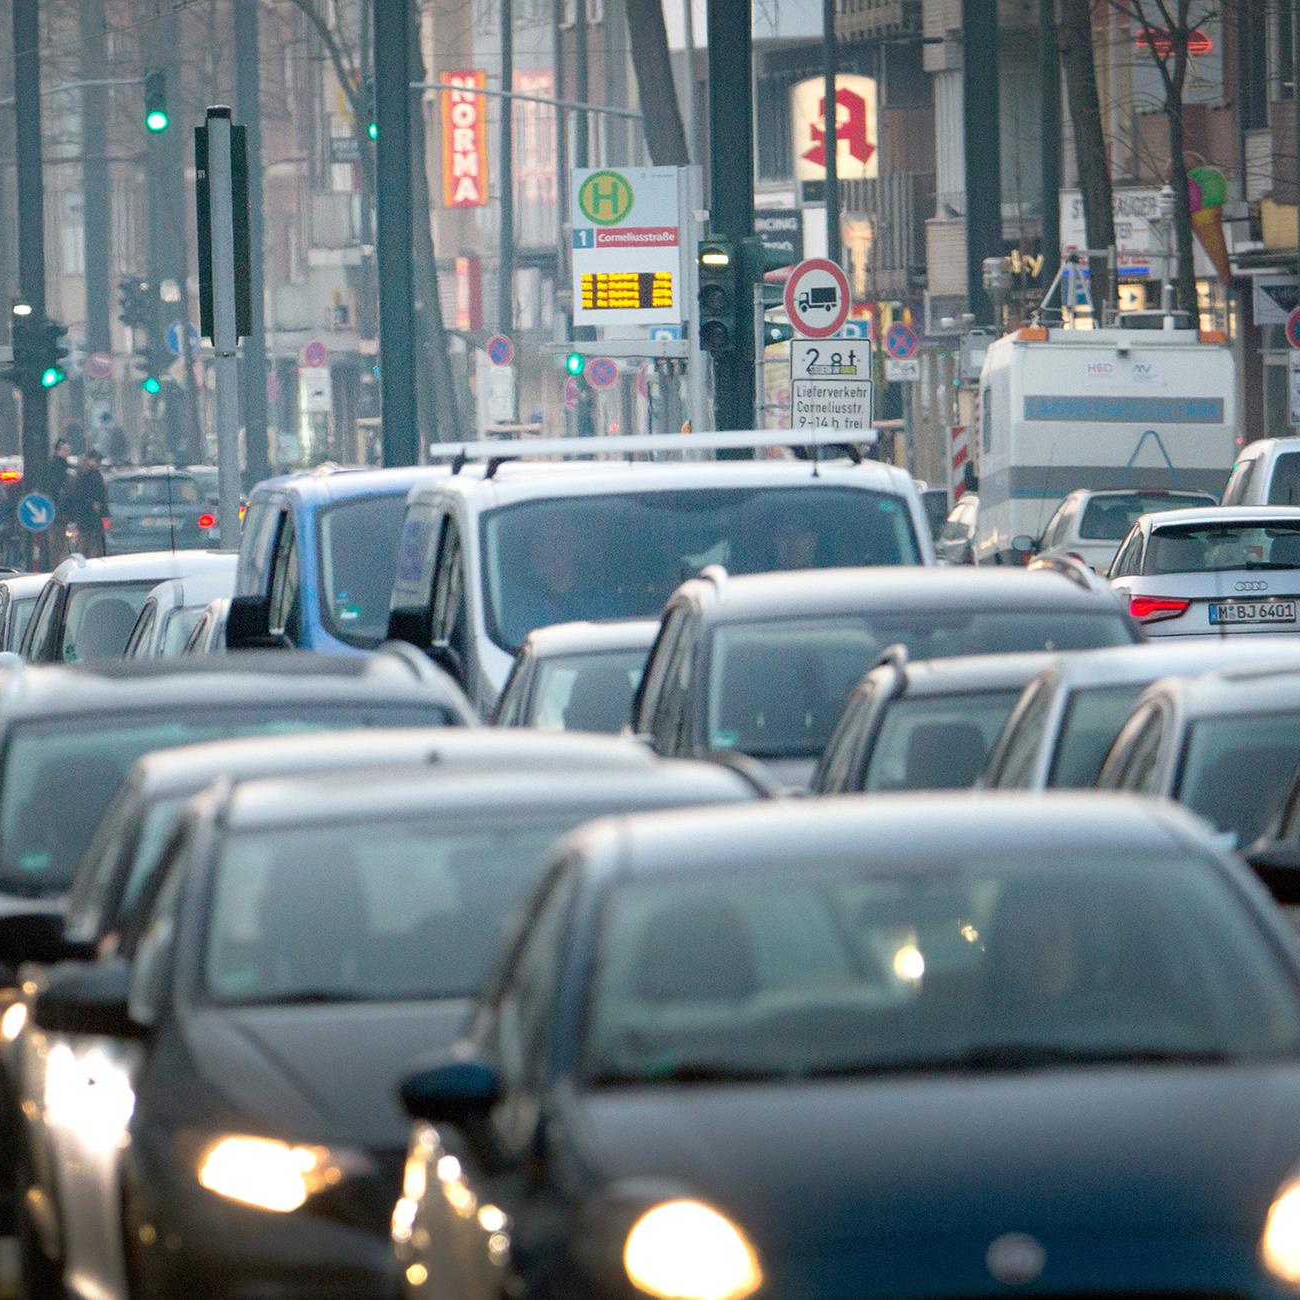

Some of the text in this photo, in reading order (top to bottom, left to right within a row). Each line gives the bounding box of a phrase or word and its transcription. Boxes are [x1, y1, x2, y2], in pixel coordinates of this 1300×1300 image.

[451, 76, 479, 202] NORMA
[592, 182, 618, 214] H
[579, 231, 586, 246] 1
[599, 232, 675, 242] Corneliusstraße
[796, 385, 867, 398] Lieferverkehr
[796, 401, 863, 414] Corneliusstr.
[844, 417, 863, 429] frei
[1218, 604, 1293, 618] M BJ 6401
